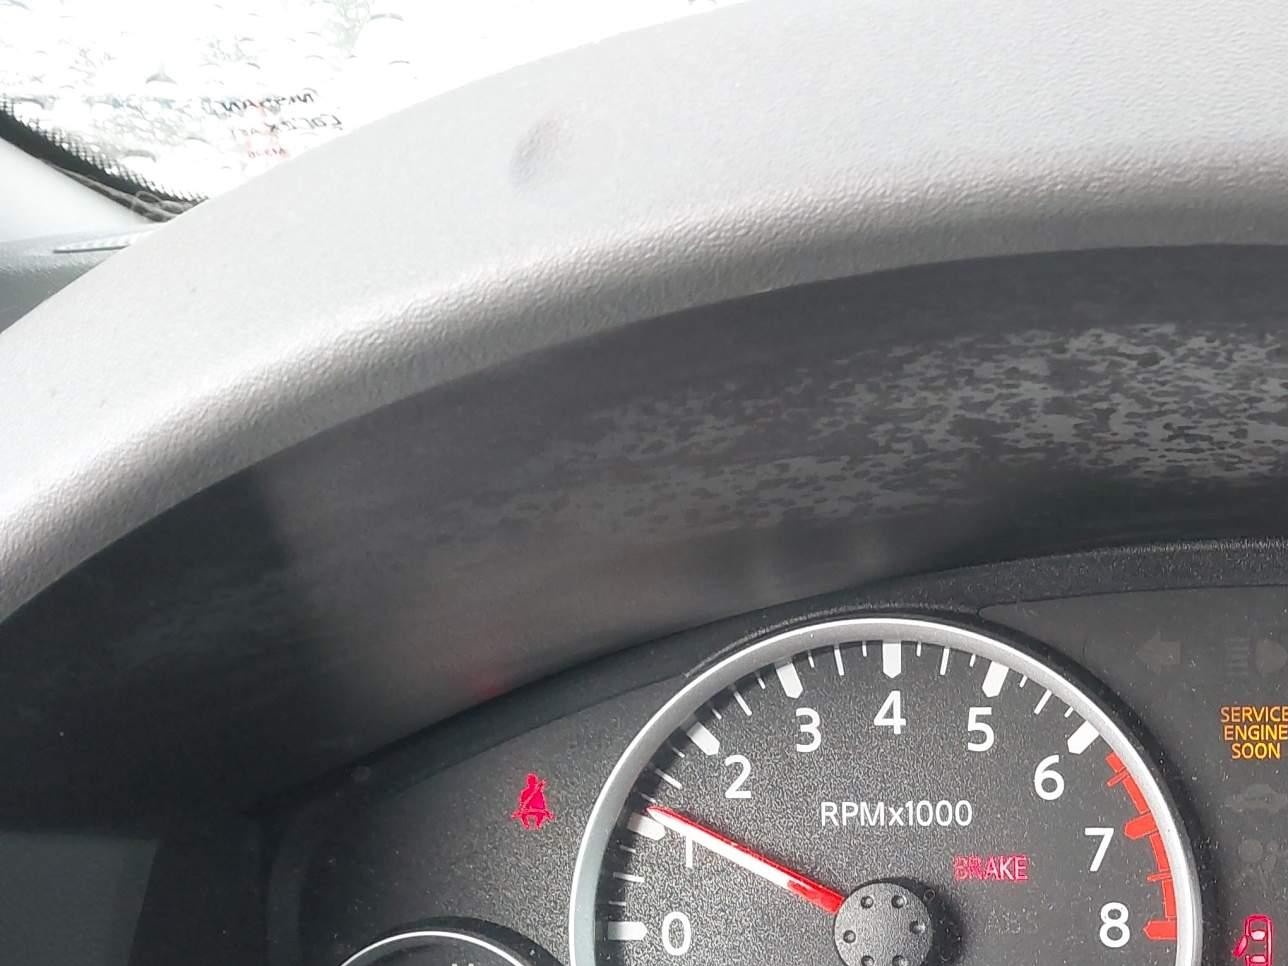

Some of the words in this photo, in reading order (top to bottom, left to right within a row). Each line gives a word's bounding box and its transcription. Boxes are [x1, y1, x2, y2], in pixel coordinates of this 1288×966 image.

[795, 707, 822, 753] 3
[873, 690, 907, 735] 4
[967, 706, 995, 752] 5
[1224, 724, 1288, 741] ENGINE
[1231, 743, 1281, 760] SOON
[724, 754, 752, 799] 2
[1033, 754, 1065, 801] 6
[820, 799, 973, 827] RPMx1000
[953, 856, 1029, 880] BRAKE
[1084, 827, 1115, 872] 7
[660, 911, 692, 956] 0
[1099, 902, 1131, 948] 8
